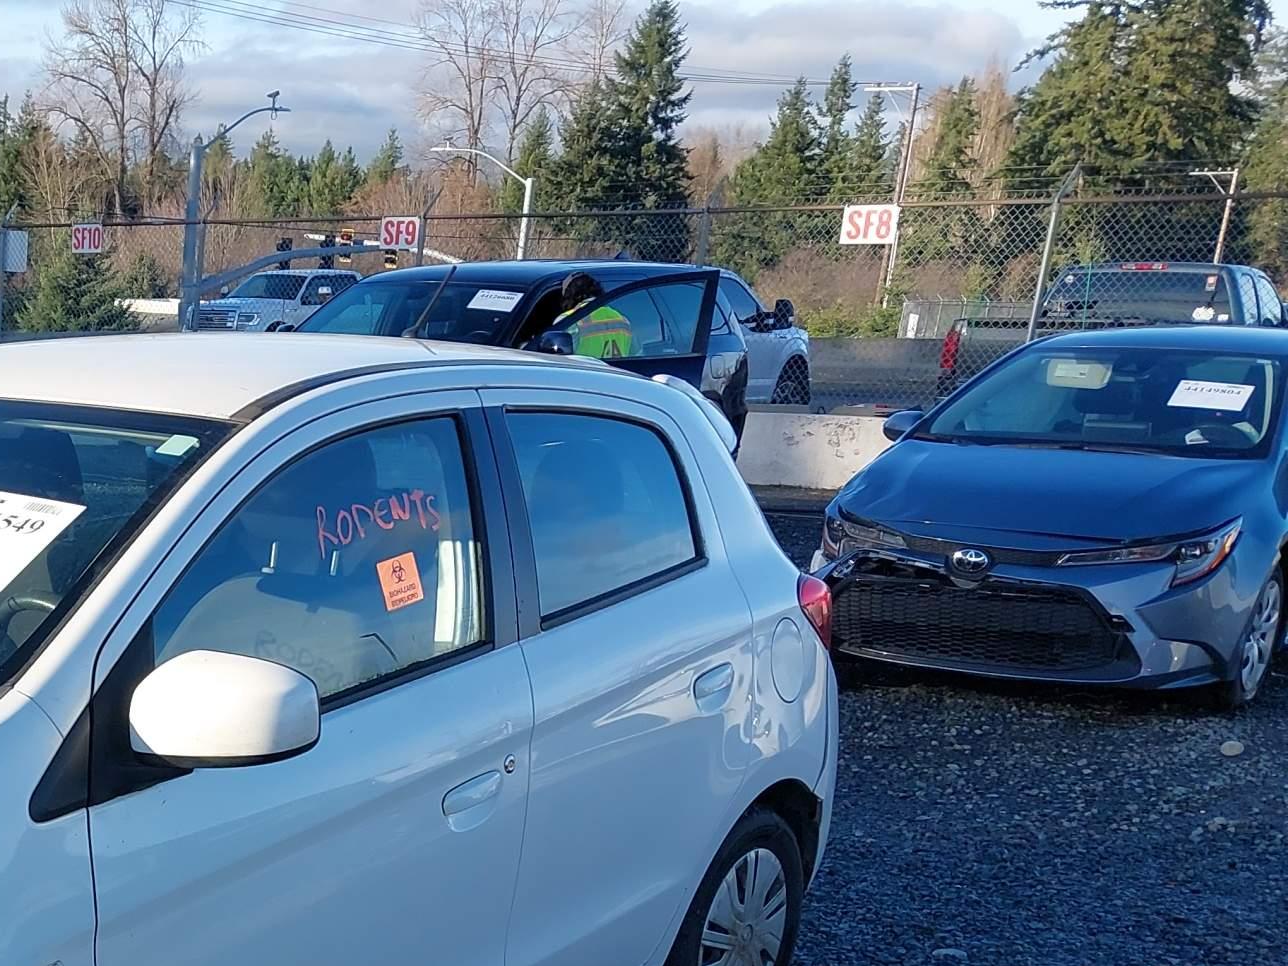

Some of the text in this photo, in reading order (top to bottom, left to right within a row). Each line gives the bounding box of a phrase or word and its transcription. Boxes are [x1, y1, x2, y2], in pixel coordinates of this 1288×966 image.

[73, 226, 101, 250] SF10
[383, 220, 417, 246] SF9
[846, 209, 893, 240] SF8
[316, 489, 441, 560] RODENTS
